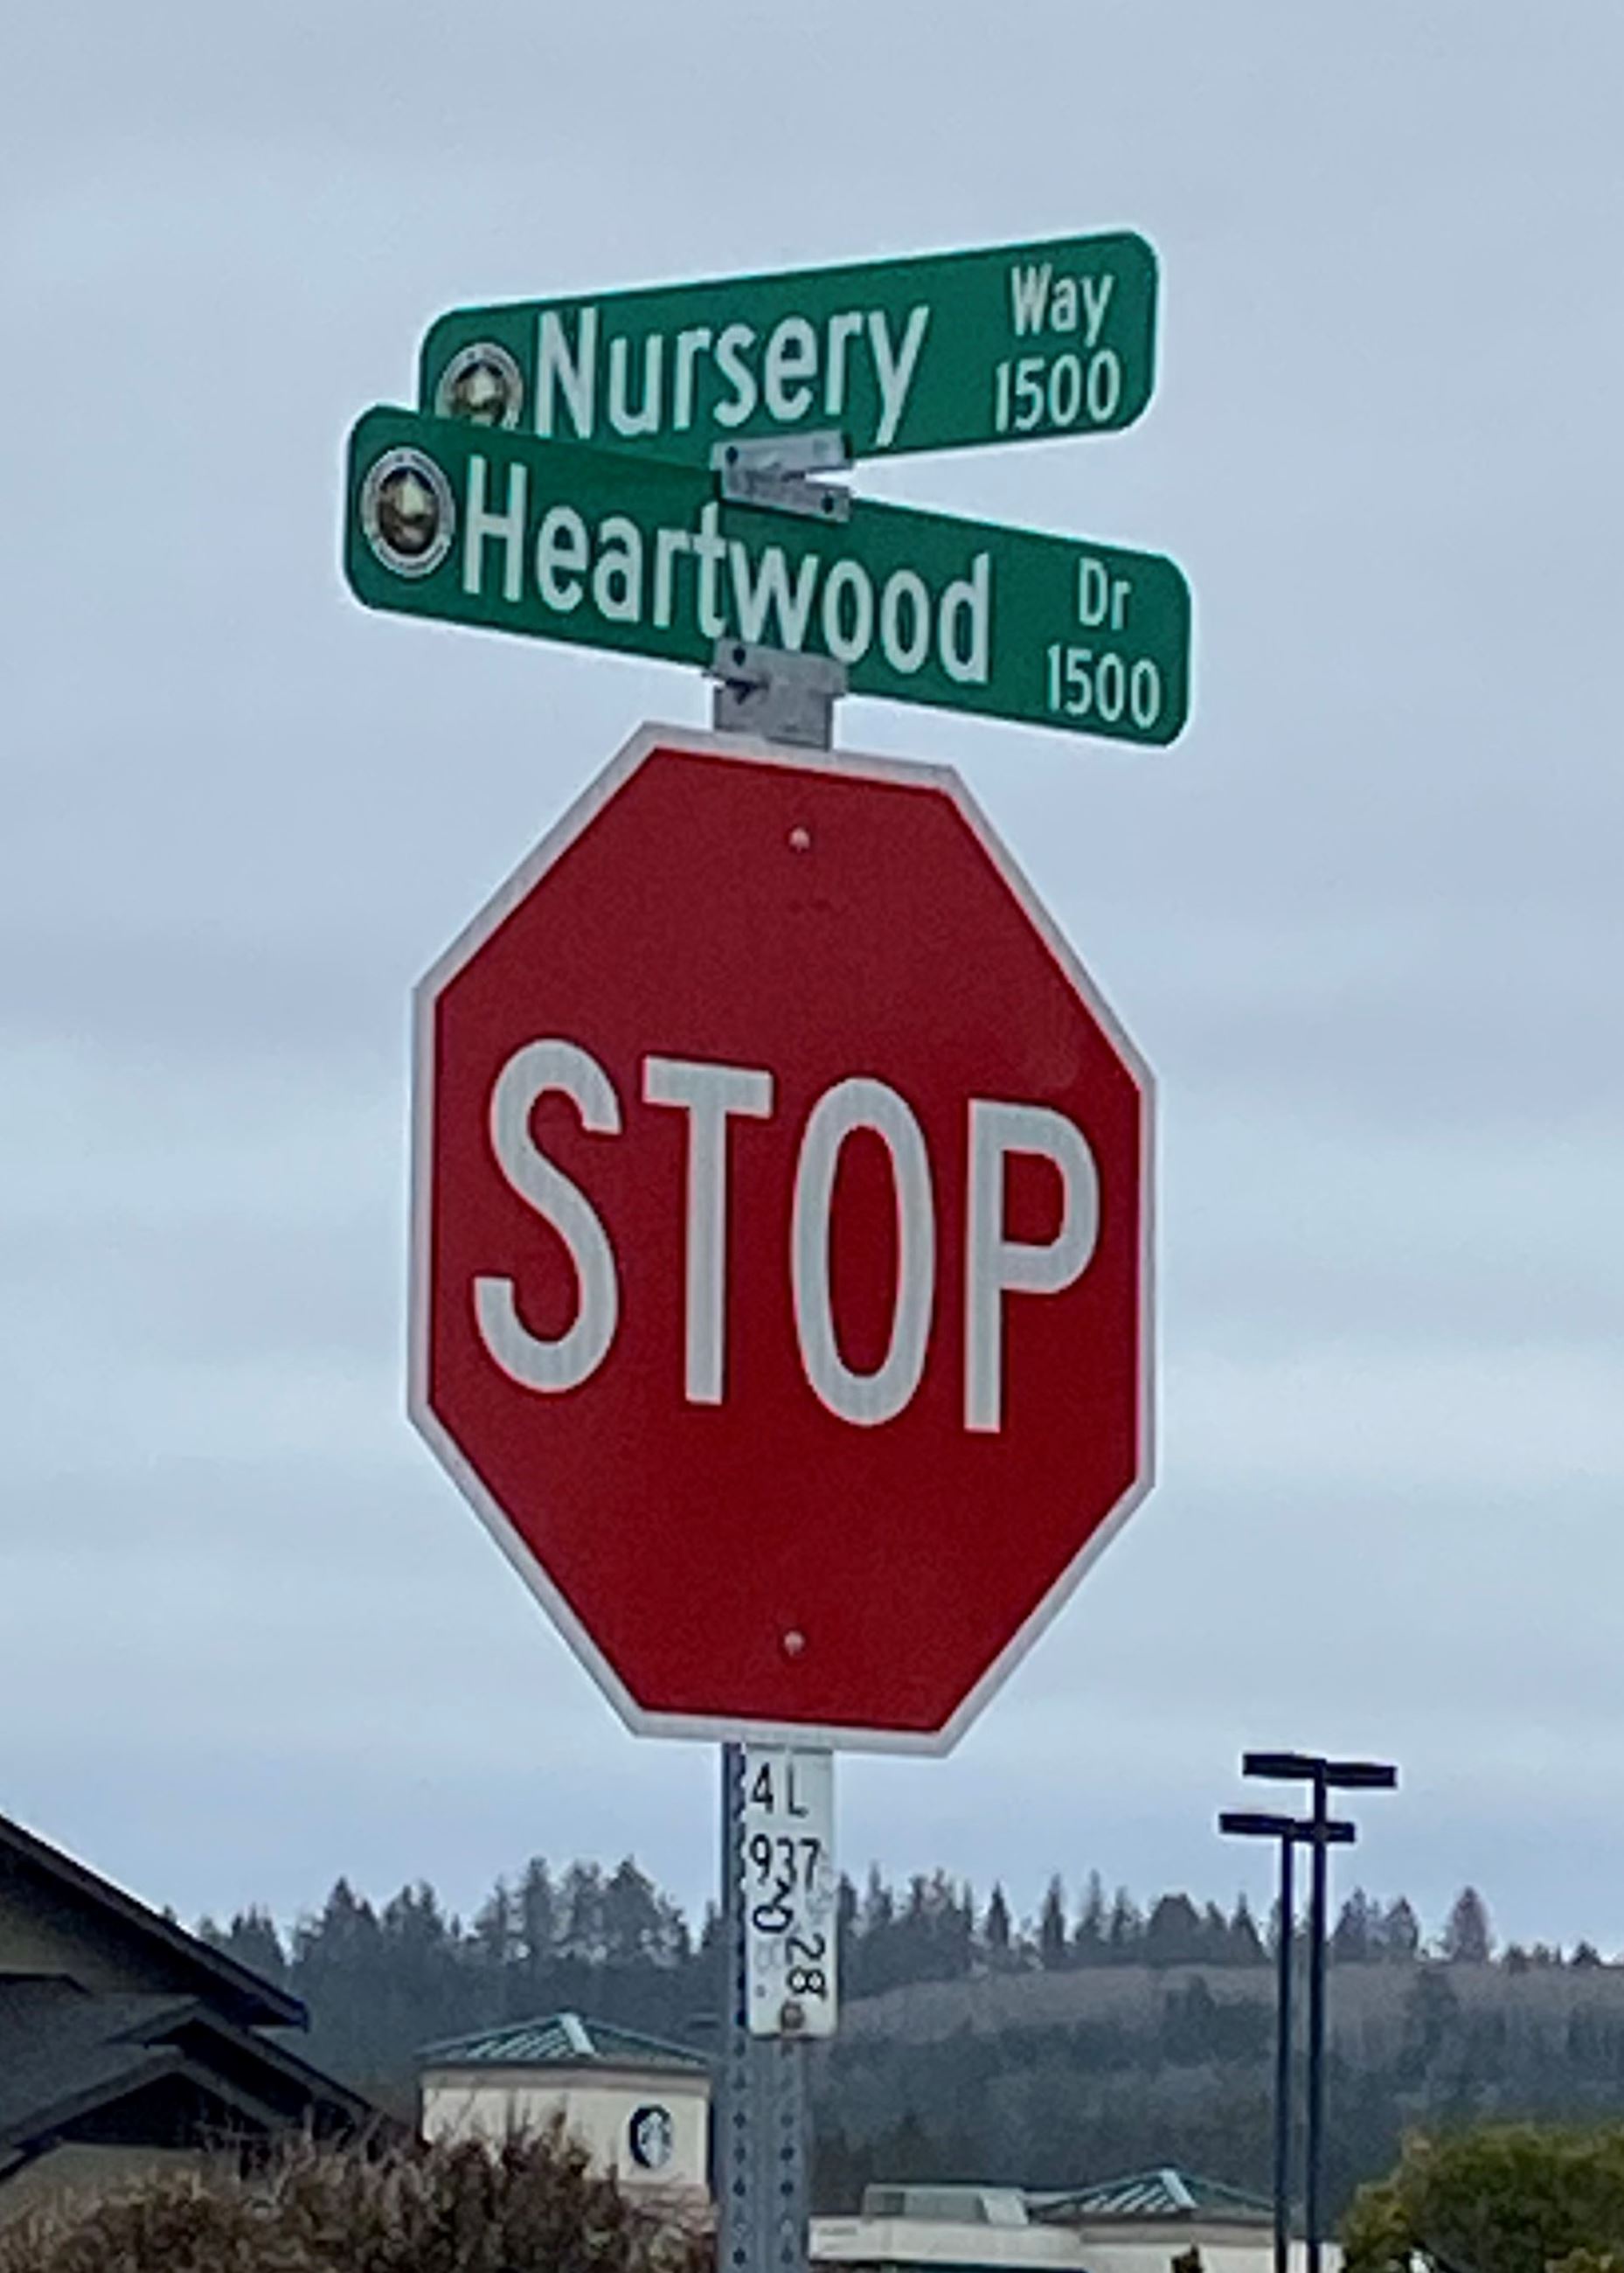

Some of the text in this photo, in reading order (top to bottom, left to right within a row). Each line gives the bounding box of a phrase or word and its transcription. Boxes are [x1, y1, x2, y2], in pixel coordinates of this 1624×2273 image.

[1010, 263, 1114, 347] Way
[535, 306, 930, 447] Nursery
[995, 349, 1121, 433] 1500
[462, 455, 990, 684] Heartwood
[1078, 556, 1132, 631] Dr
[1048, 643, 1161, 729] 1500
[473, 1038, 1100, 1434] STOP
